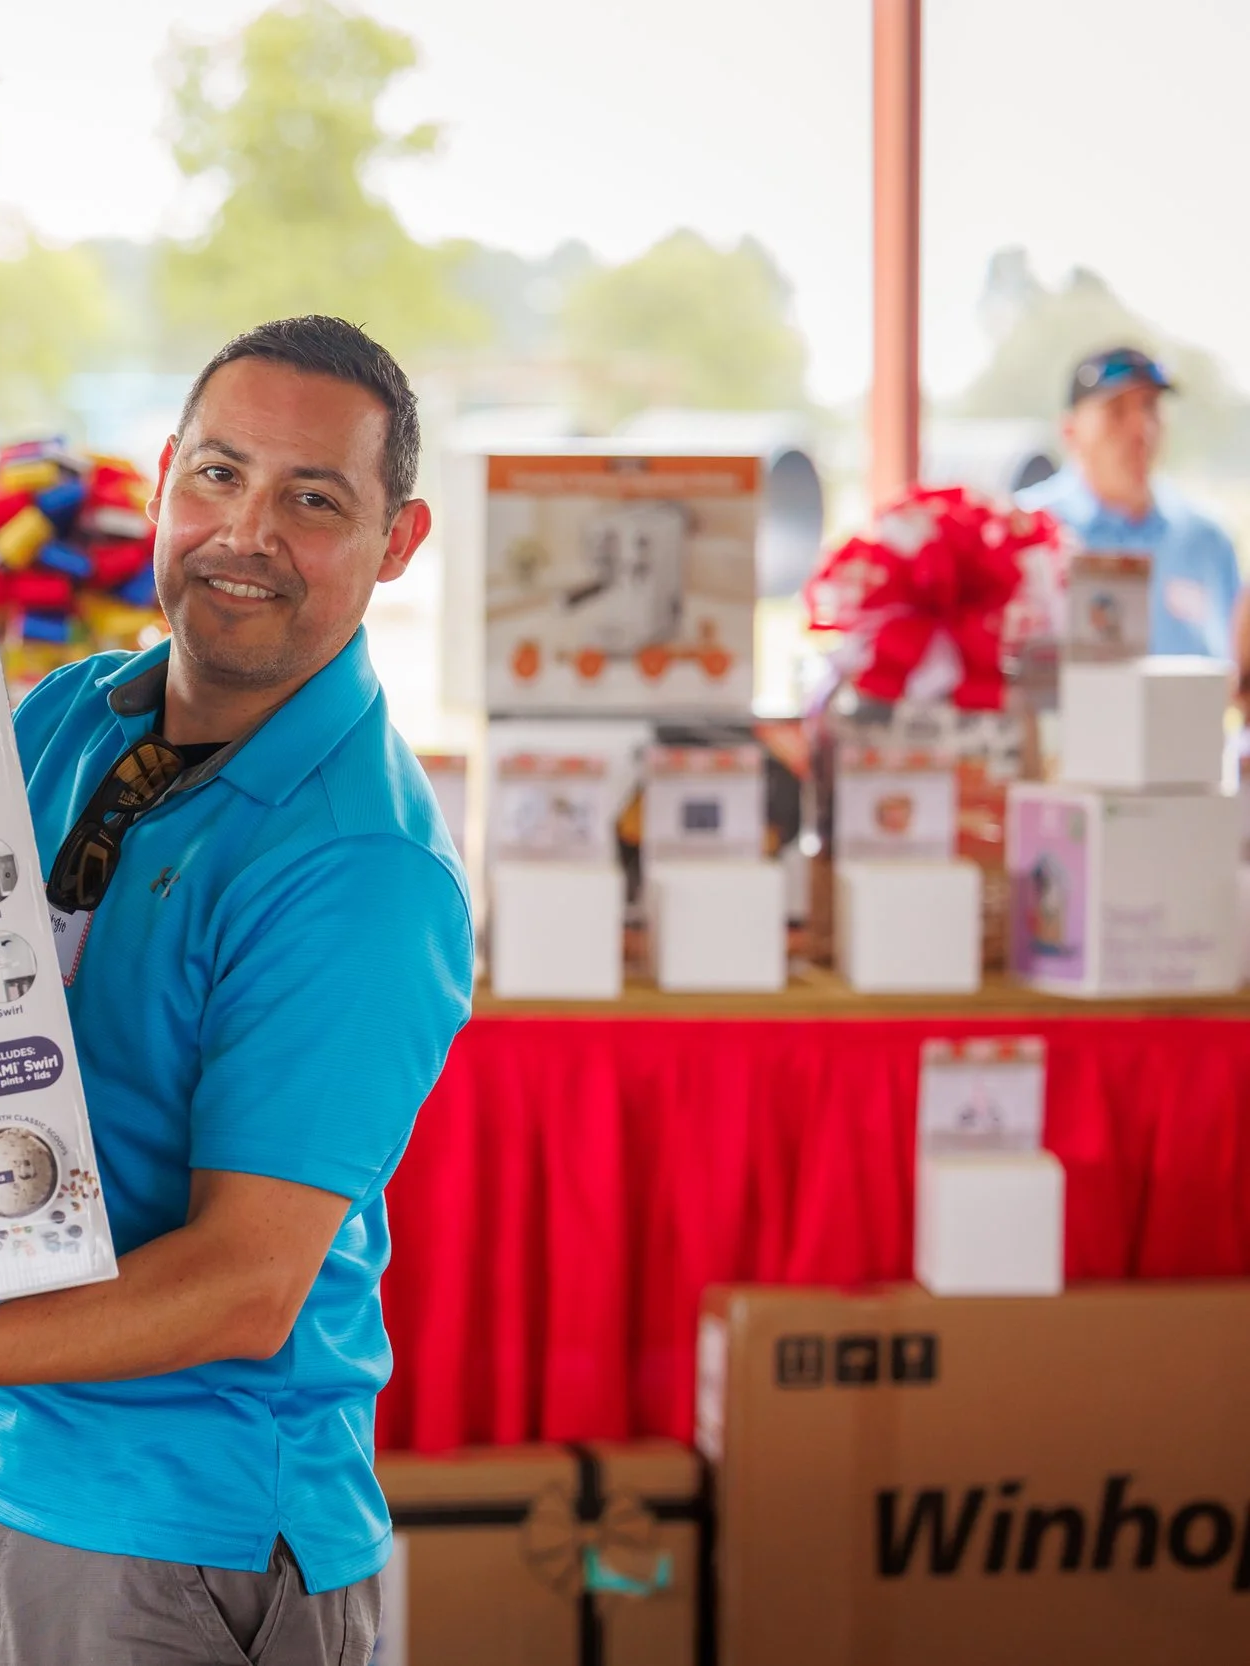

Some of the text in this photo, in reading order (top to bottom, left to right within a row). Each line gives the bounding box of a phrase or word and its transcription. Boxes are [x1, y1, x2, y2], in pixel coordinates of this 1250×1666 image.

[24, 1055, 58, 1072] Swirl
[0, 1075, 24, 1088] pints
[33, 1071, 51, 1081] lids
[14, 1114, 46, 1130] CLASSIC
[46, 1127, 68, 1156] SCOOPS
